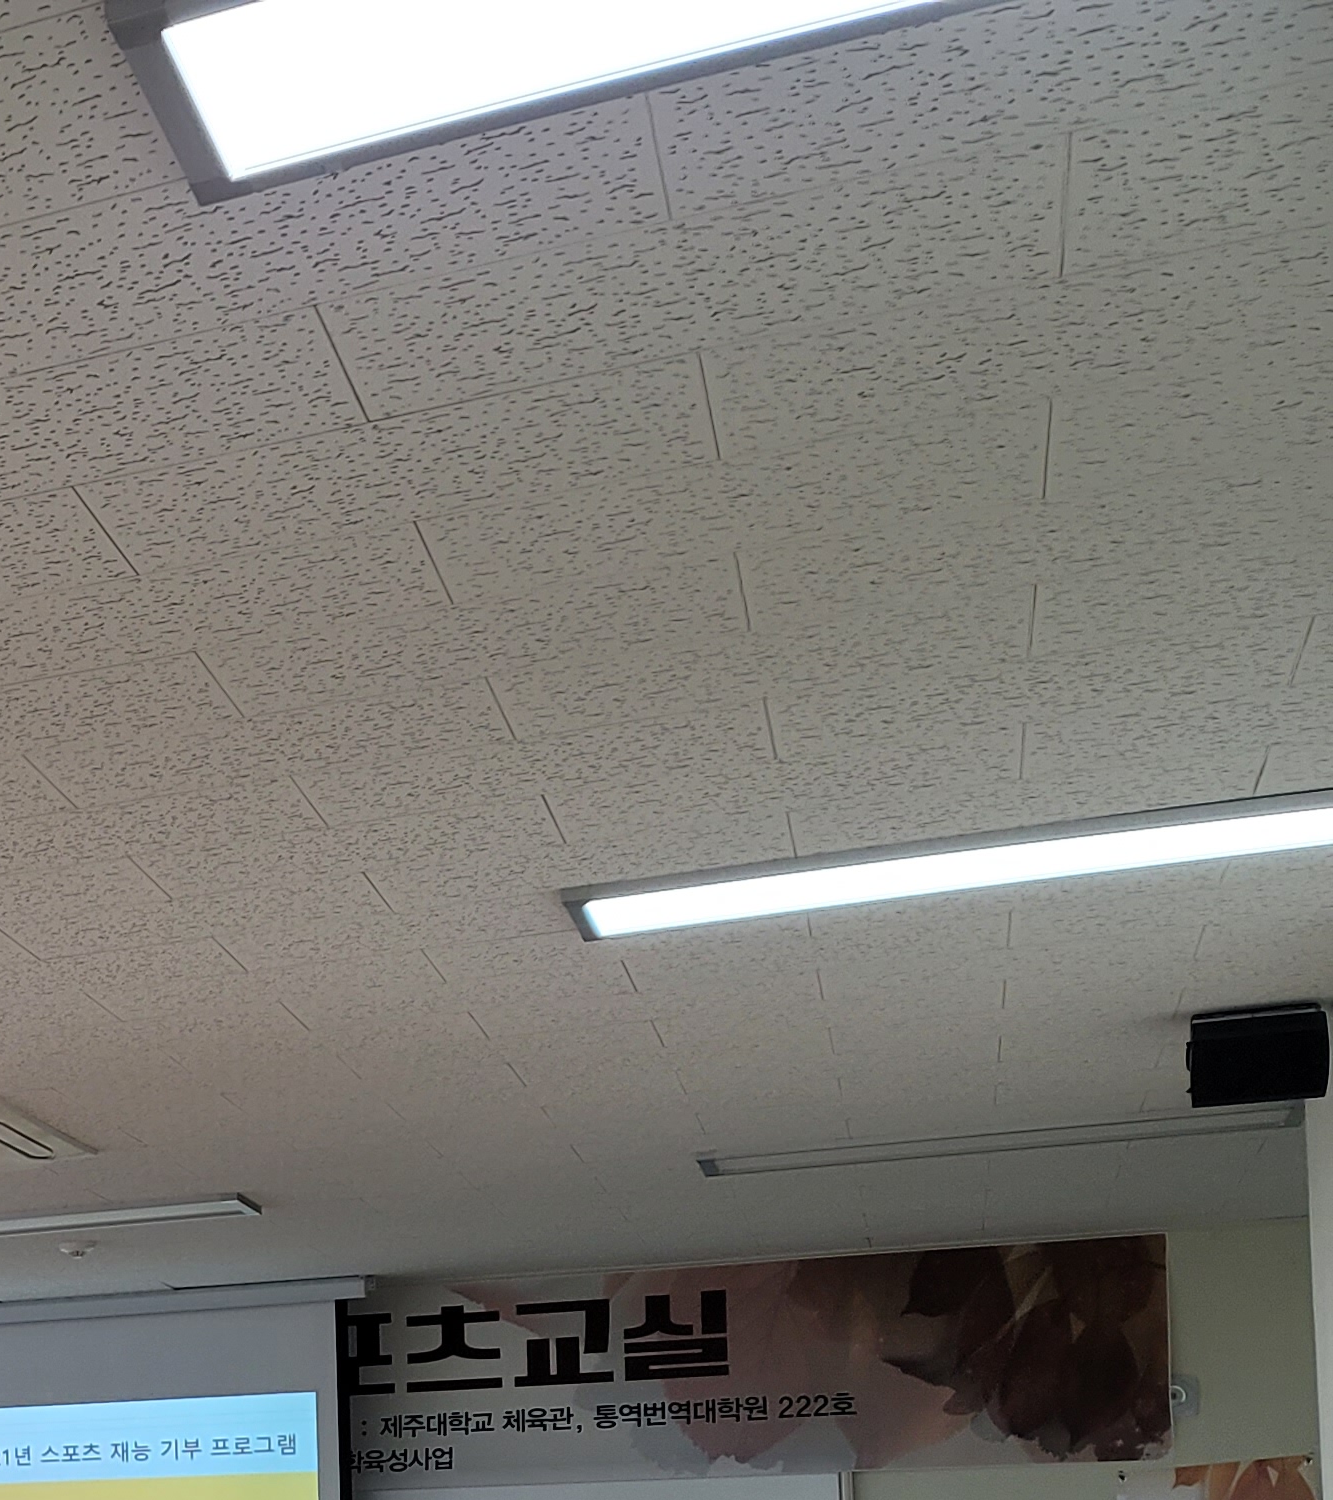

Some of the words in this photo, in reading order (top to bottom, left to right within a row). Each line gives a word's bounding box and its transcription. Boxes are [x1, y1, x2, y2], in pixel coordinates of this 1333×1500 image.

[379, 1410, 495, 1439] 제주대학교
[502, 1406, 583, 1434] 체육관,
[592, 1395, 769, 1429] 통역번역대학원
[778, 1391, 858, 1418] 222호
[39, 1442, 102, 1463] 스포츠
[110, 1440, 152, 1463] 재능
[160, 1438, 202, 1460] 기부
[209, 1433, 297, 1457] 프로그램
